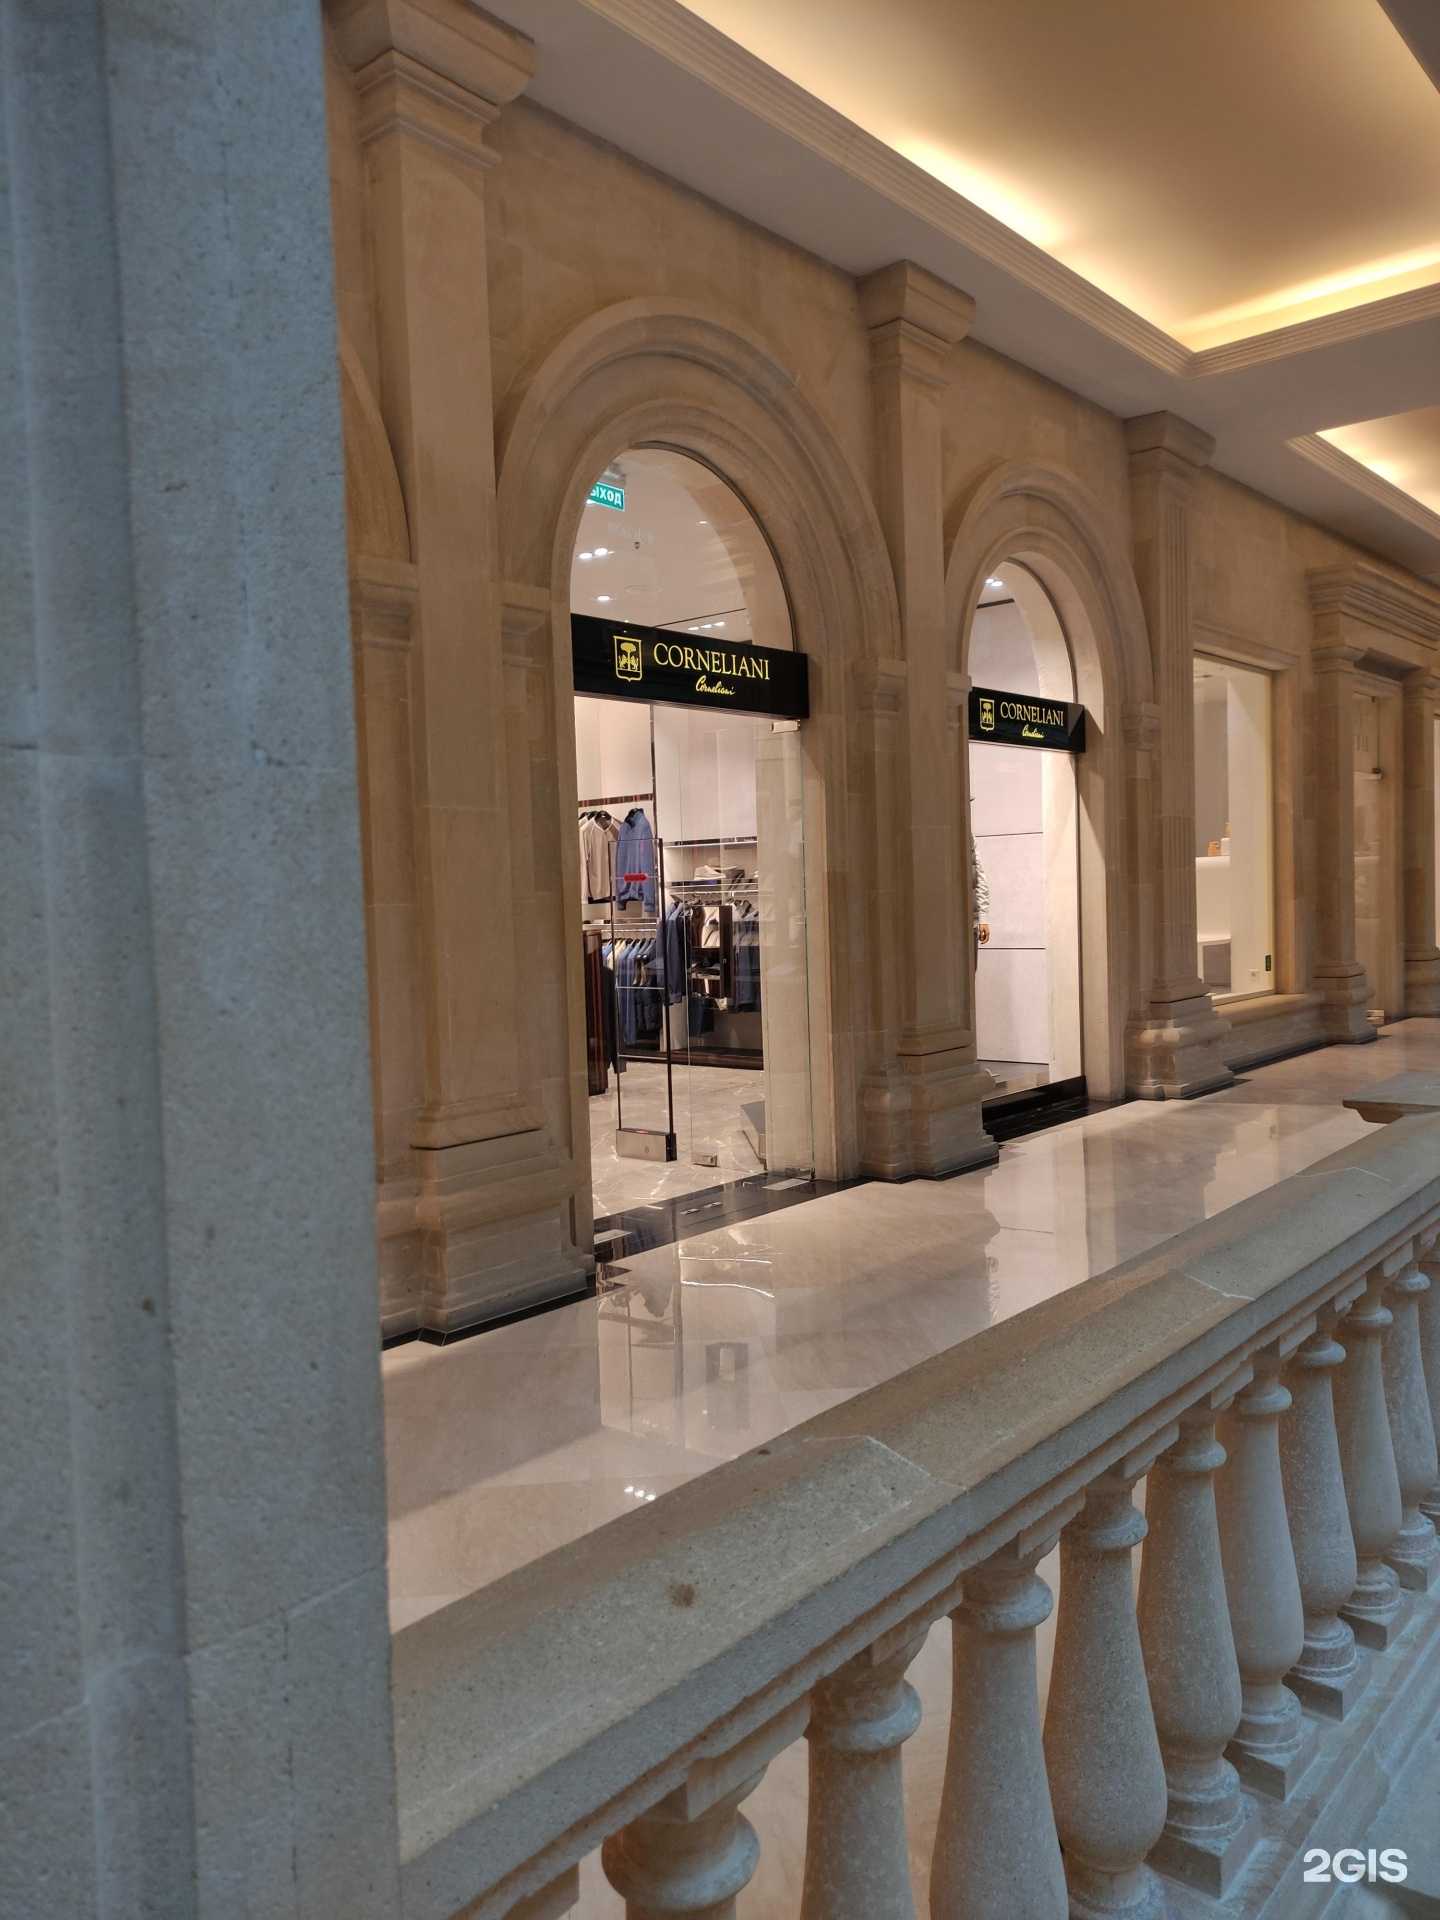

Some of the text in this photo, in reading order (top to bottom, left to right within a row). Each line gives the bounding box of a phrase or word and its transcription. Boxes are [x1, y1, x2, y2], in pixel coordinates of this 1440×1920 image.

[590, 486, 622, 508] ЫХОД
[653, 642, 770, 681] CORNELIANI
[1000, 701, 1064, 727] CORNELIANI
